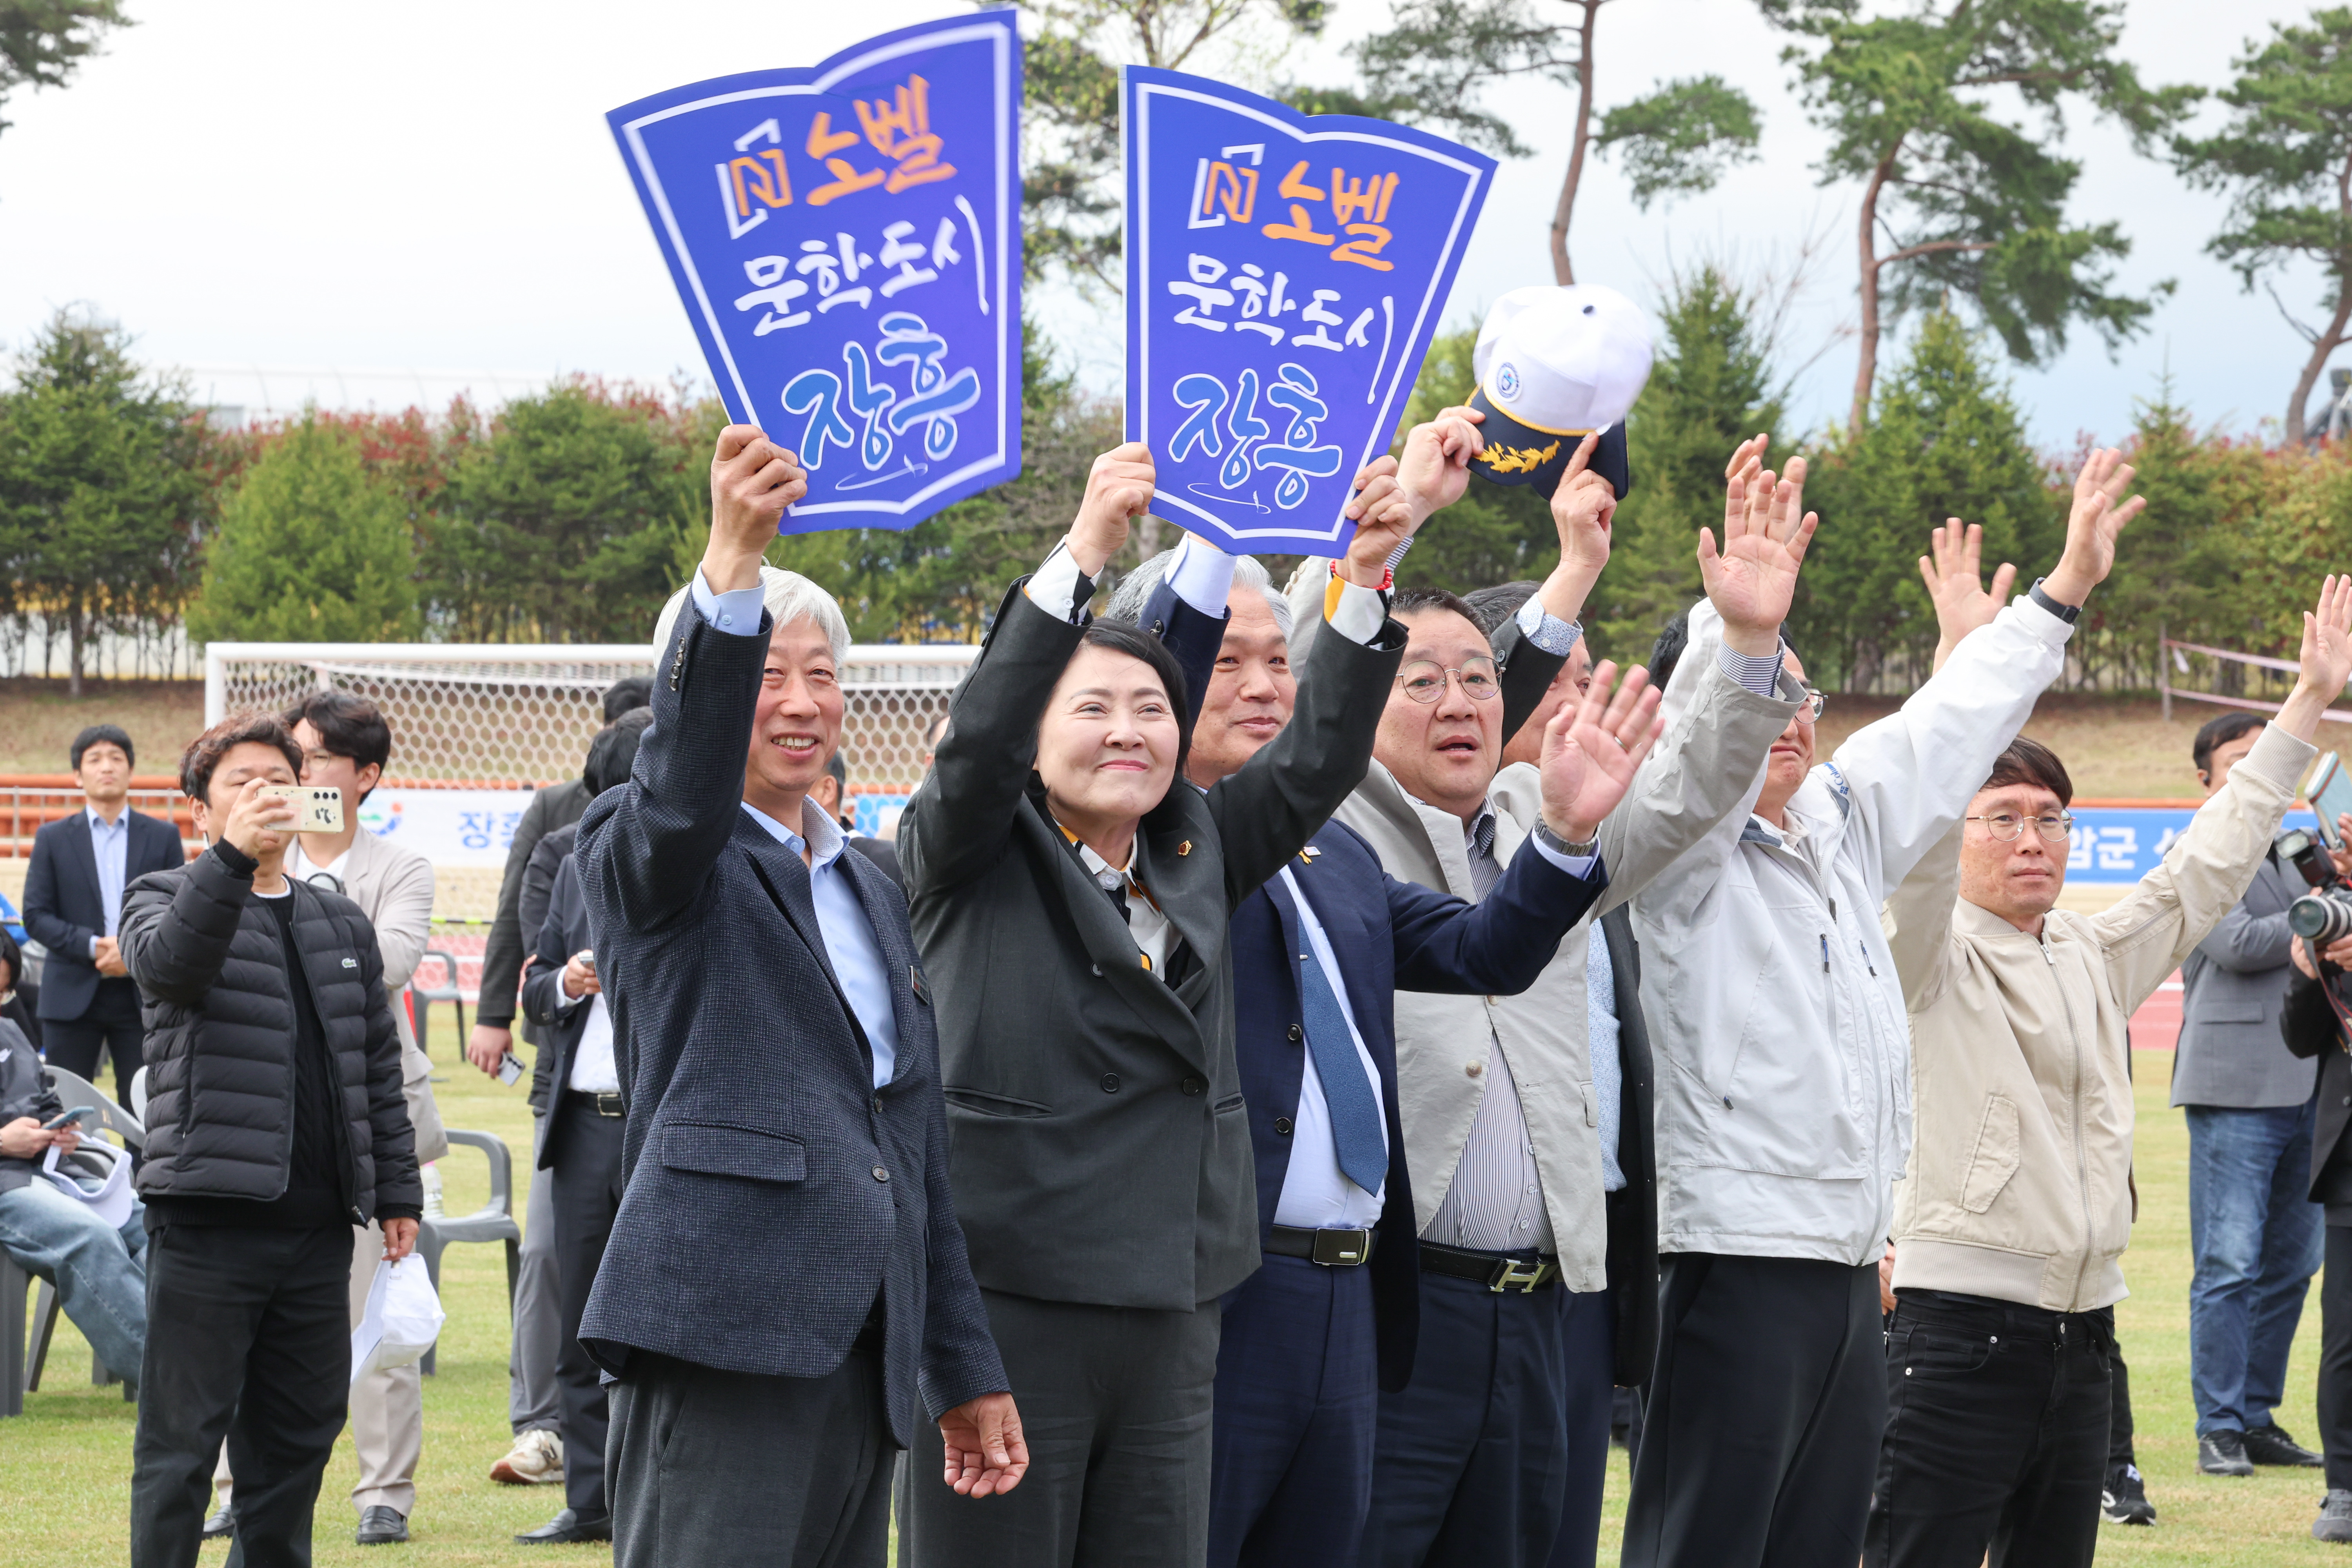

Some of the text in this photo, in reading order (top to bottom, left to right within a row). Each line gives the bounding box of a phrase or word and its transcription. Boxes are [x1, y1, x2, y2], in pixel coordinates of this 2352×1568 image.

[806, 73, 958, 206] 노벨
[733, 194, 990, 337] 문학도시
[1261, 160, 1400, 271] 노벨
[780, 311, 981, 471] 장흥
[1167, 252, 1394, 405] 문학도시
[1168, 363, 1343, 510] 장흥
[1822, 762, 1844, 786] Columb
